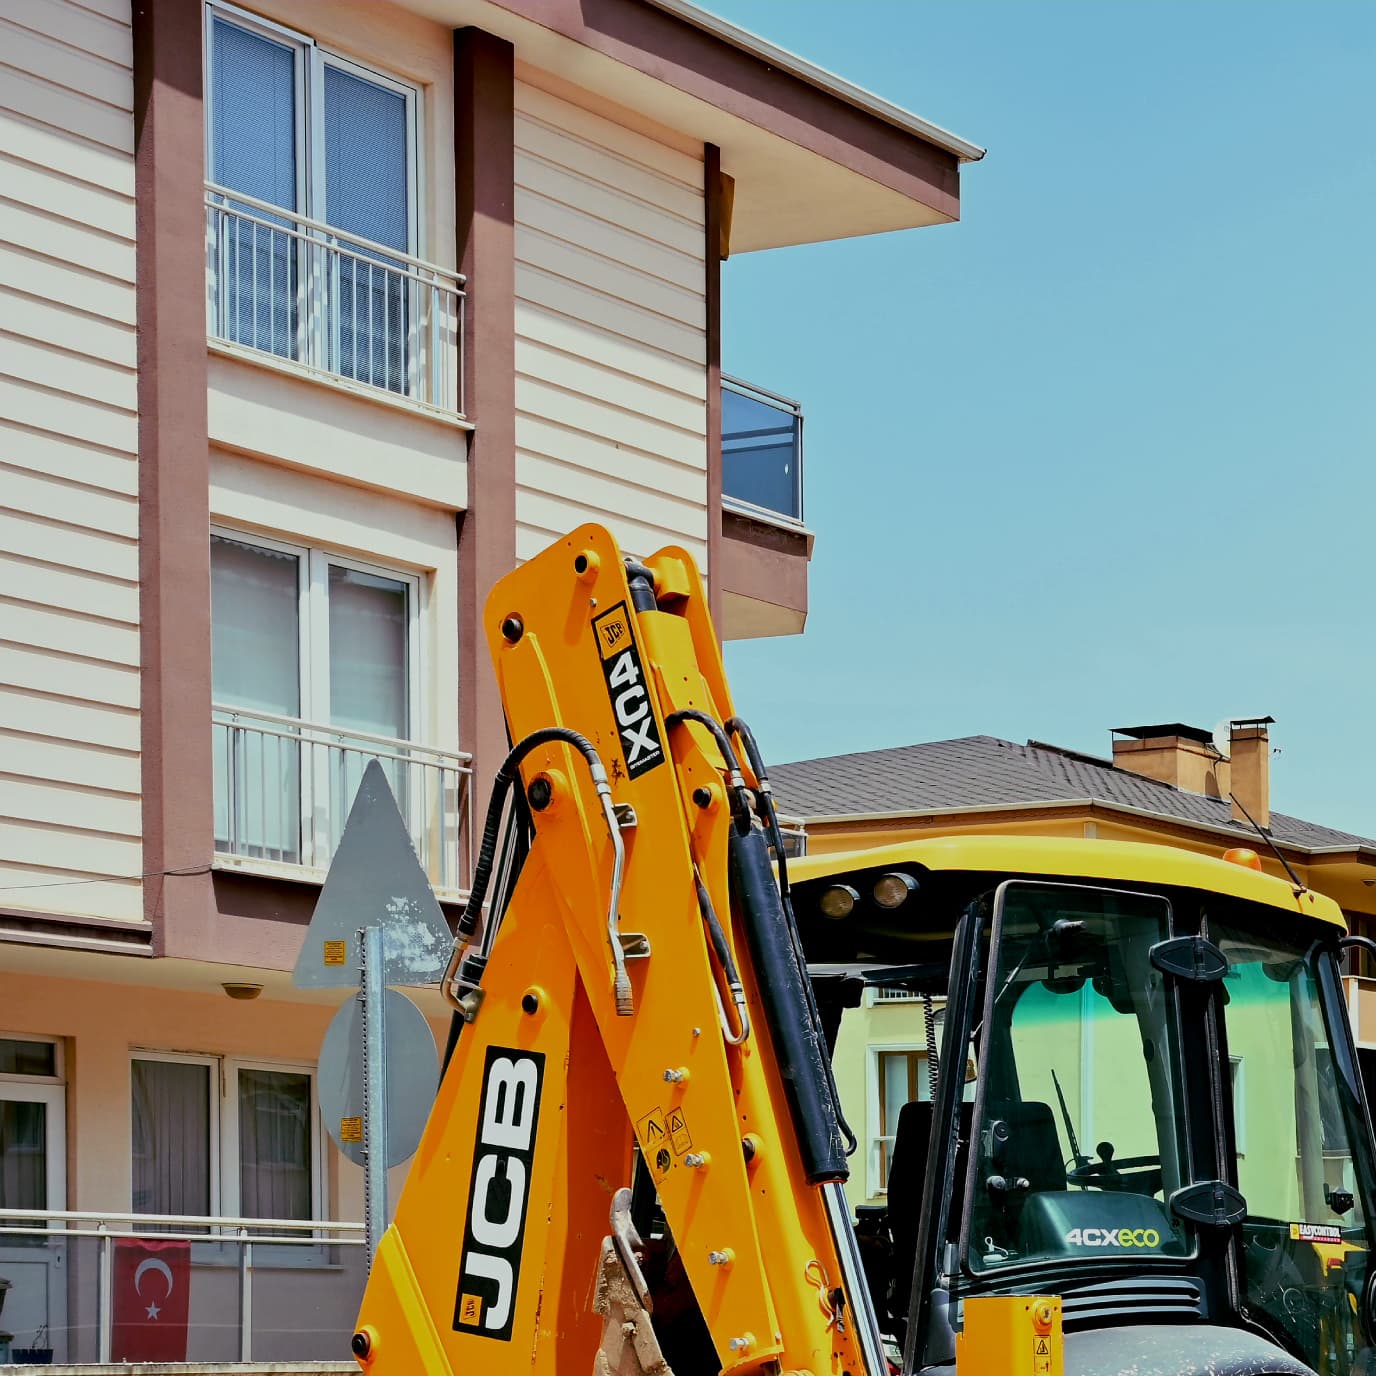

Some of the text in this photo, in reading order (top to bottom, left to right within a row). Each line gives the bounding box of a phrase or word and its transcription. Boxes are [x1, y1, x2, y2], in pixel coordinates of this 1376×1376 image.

[609, 651, 659, 764] 4CX
[465, 1057, 538, 1330] JCB
[1065, 1228, 1160, 1248] 4CXeco
